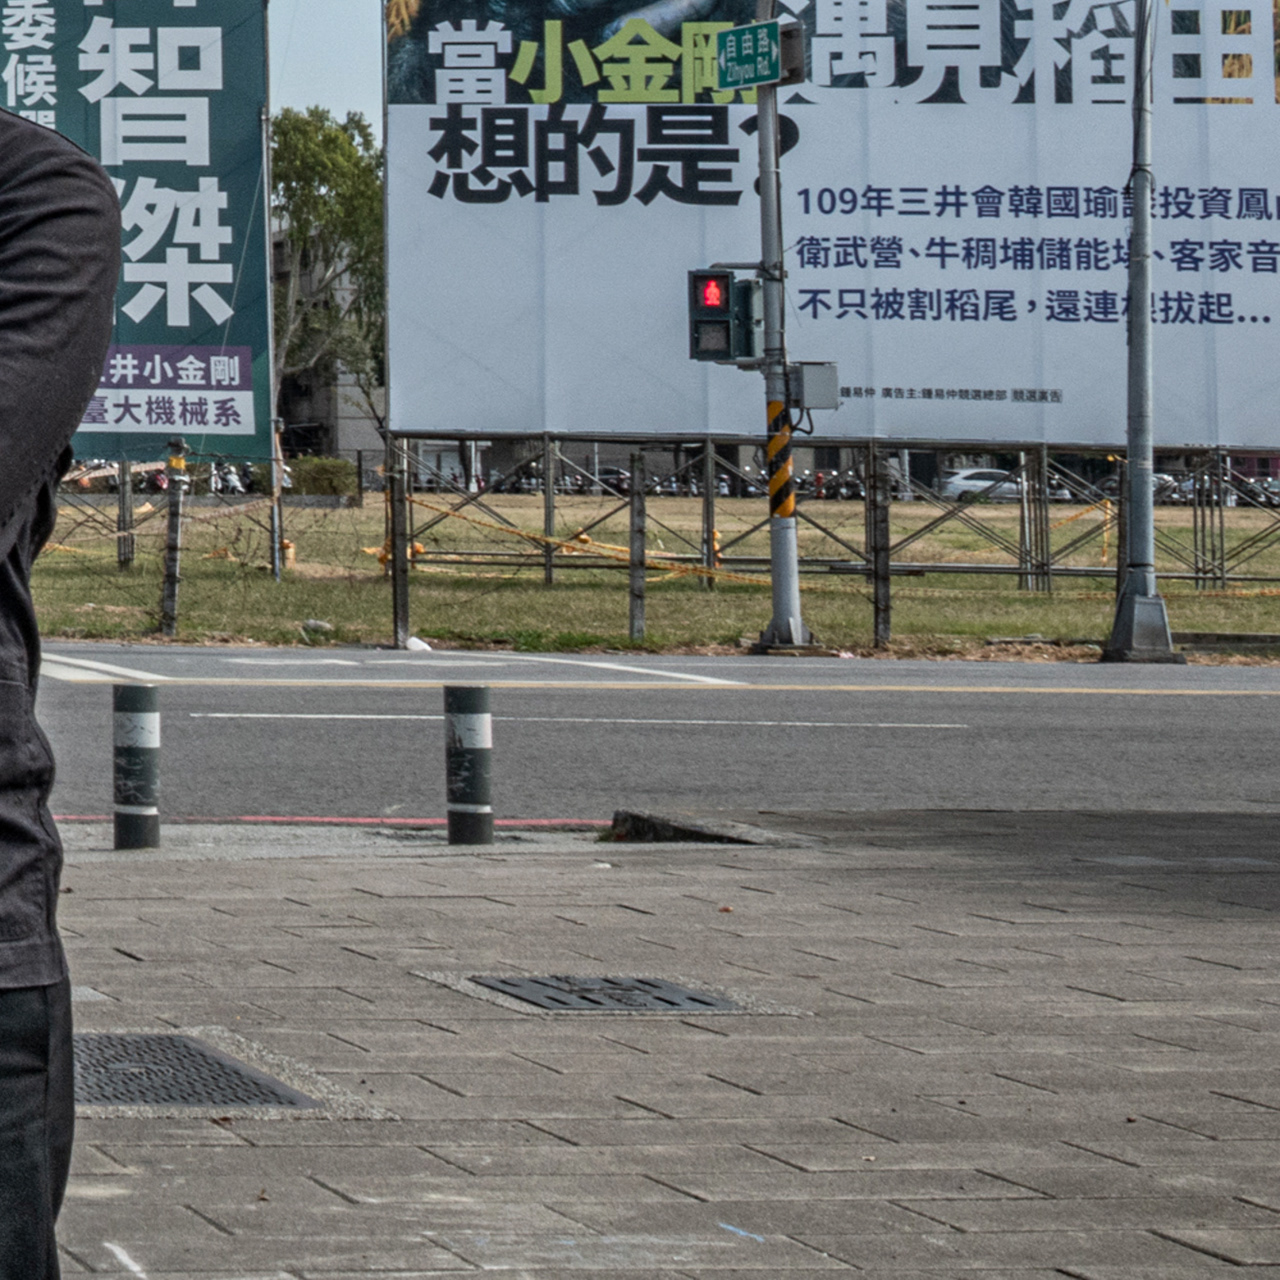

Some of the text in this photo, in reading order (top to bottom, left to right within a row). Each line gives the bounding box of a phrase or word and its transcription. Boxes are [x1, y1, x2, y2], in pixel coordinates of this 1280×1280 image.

[726, 27, 769, 59] 自由路
[797, 184, 1280, 220] 109年三井會韓國瑜投資鳳
[100, 353, 240, 386] 井小金剛
